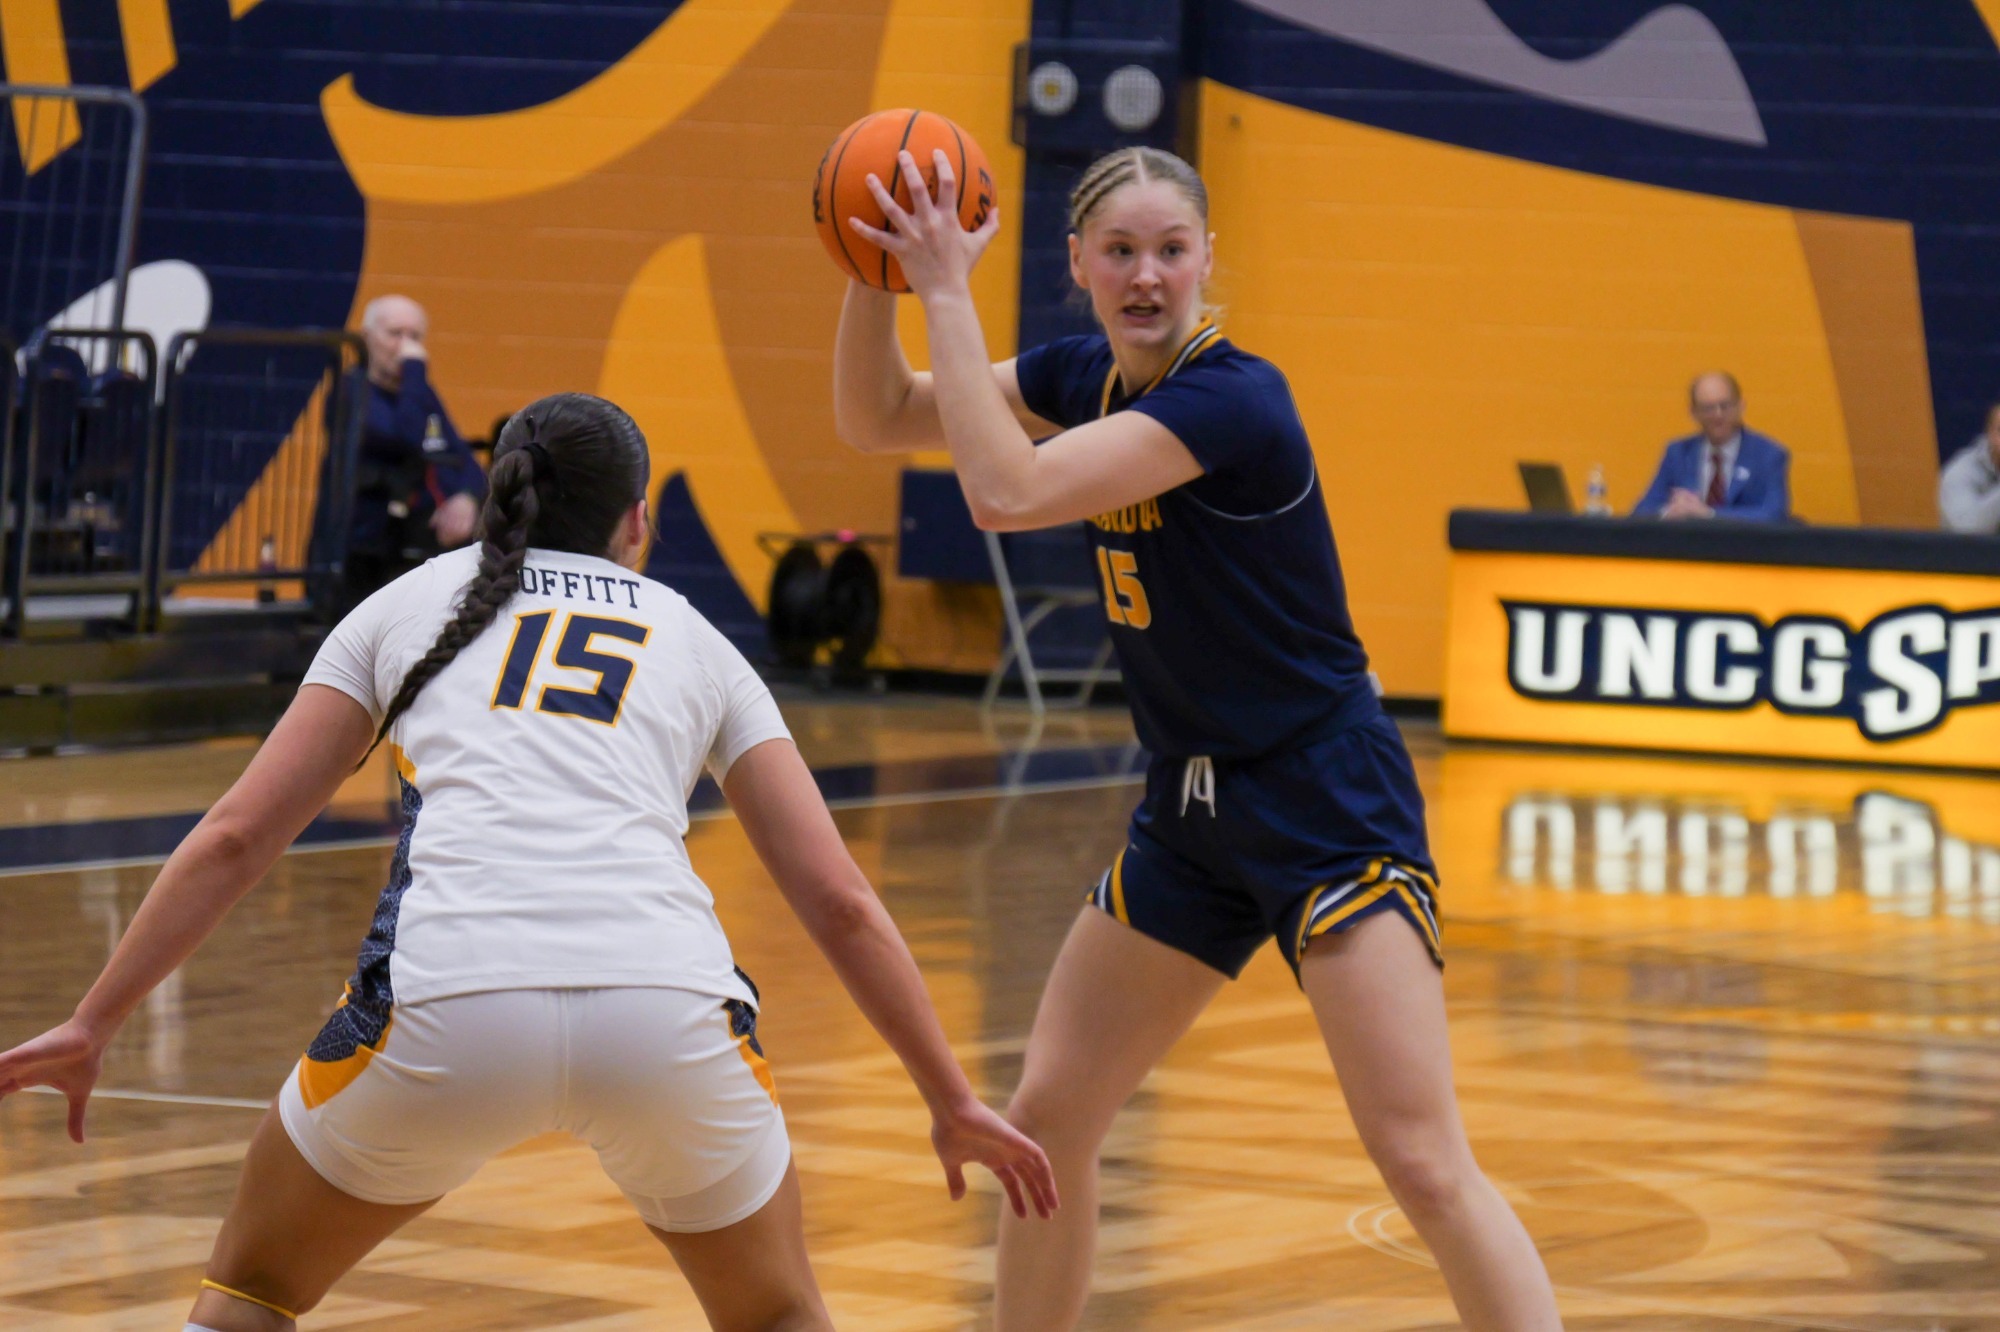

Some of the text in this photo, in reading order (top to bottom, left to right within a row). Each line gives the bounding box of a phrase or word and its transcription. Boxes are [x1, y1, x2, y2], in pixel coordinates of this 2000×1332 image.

[519, 566, 640, 609] OFFITT
[1096, 544, 1152, 630] 15
[490, 608, 653, 728] 15
